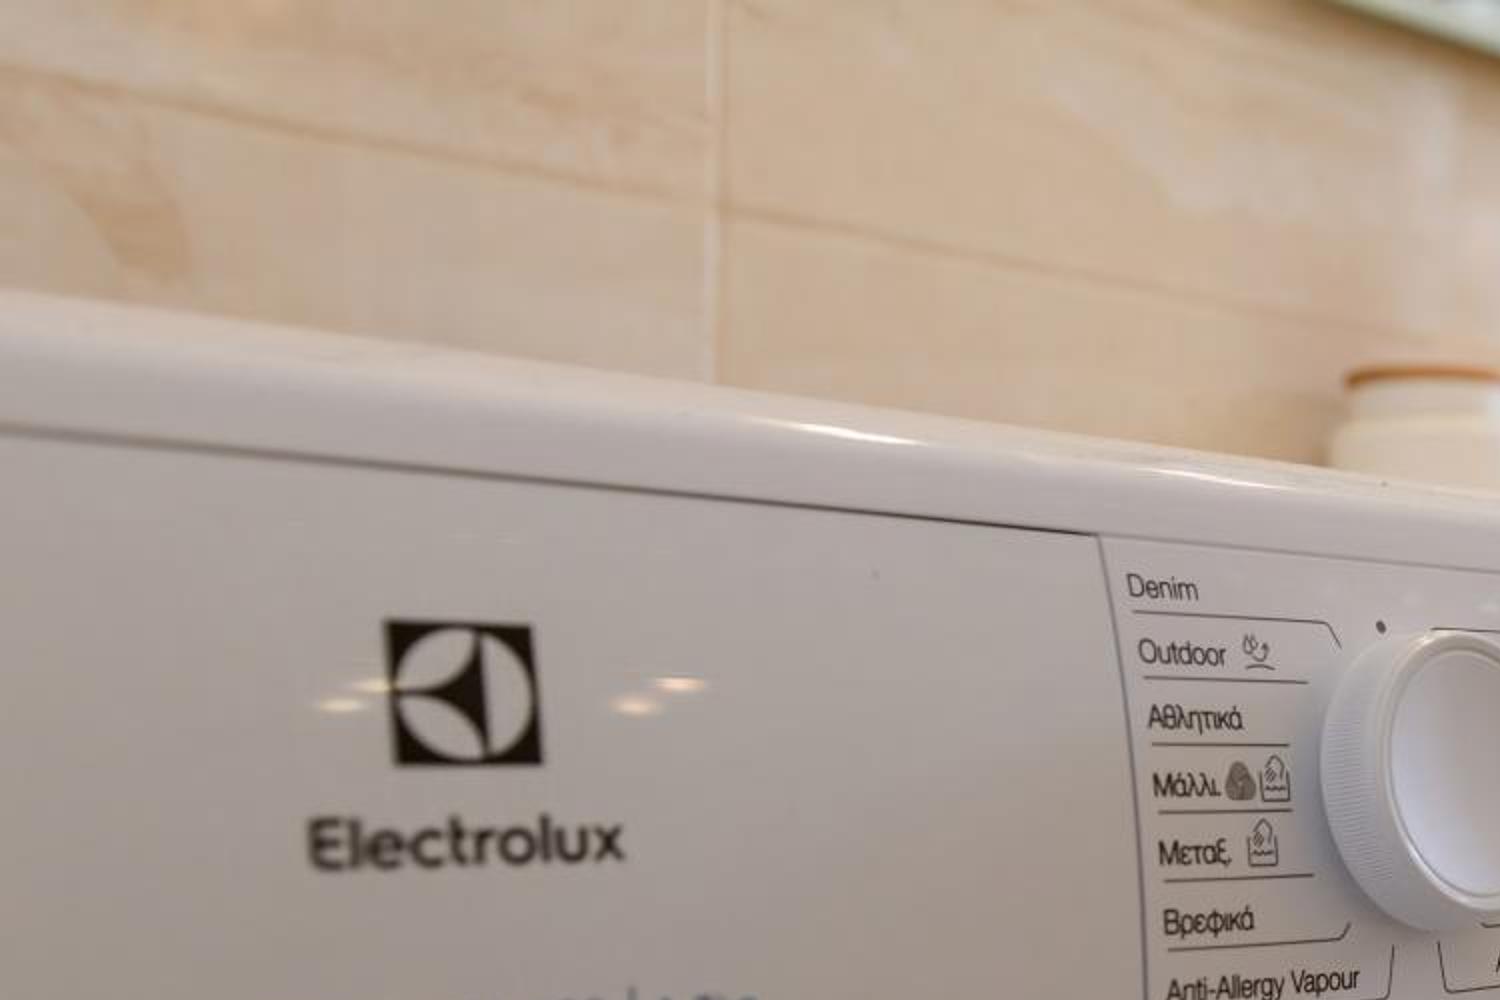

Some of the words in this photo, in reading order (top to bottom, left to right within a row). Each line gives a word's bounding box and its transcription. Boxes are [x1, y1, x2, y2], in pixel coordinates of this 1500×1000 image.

[1126, 572, 1199, 601] Denim
[1138, 637, 1227, 667] Outdoor
[1148, 703, 1244, 736] Αθλητικά
[306, 814, 628, 871] Electrolux
[1162, 905, 1255, 939] Βρεφικά
[1291, 968, 1361, 997] Vapour
